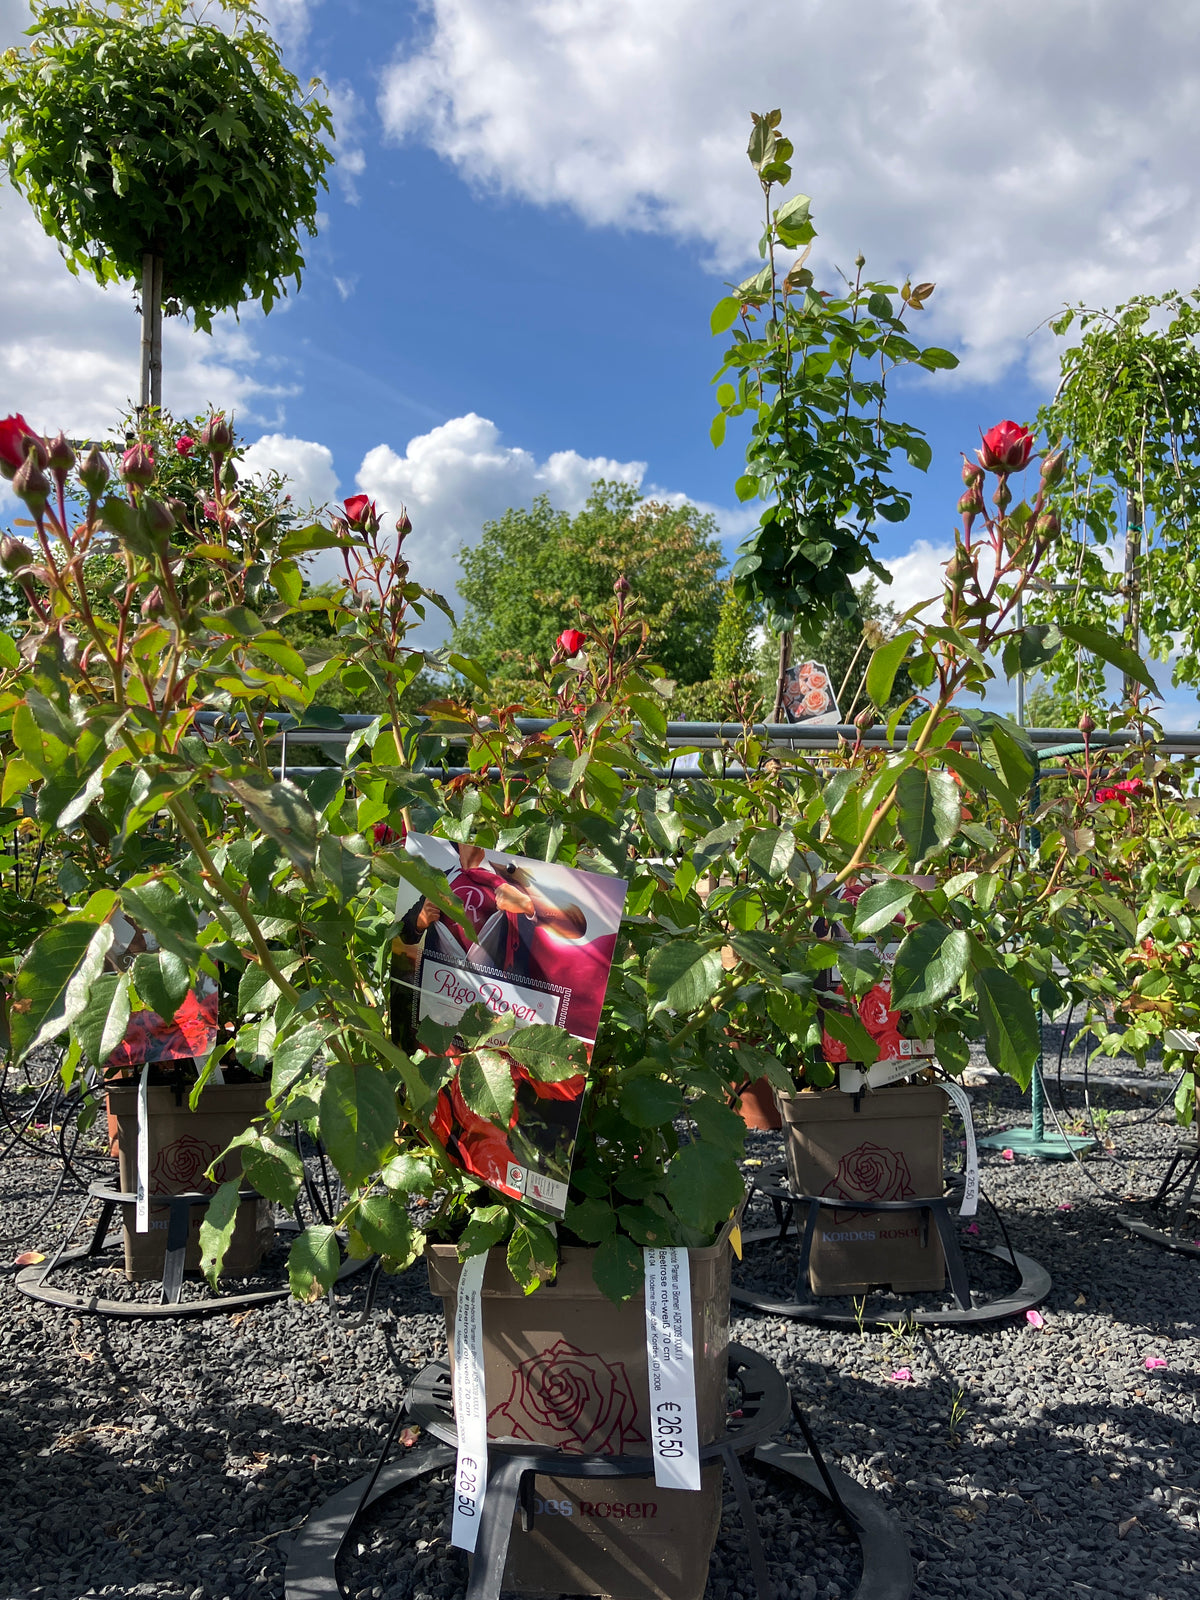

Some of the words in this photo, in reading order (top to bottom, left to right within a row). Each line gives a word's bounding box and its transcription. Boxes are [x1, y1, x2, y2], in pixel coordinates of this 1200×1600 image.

[434, 969, 476, 1005] Rigo
[479, 982, 537, 1022] Rosen
[659, 1250, 668, 1287] Beetrose
[661, 1290, 671, 1330] rot-weiß
[673, 1312, 682, 1325] ADR
[662, 1332, 672, 1344] 70
[663, 1346, 671, 1361] cm
[465, 1389, 472, 1400] 70
[466, 1402, 470, 1416] cm
[656, 1402, 682, 1412] €
[654, 1416, 684, 1458] 26,50
[462, 1457, 477, 1470] €
[457, 1470, 476, 1517] 26,50
